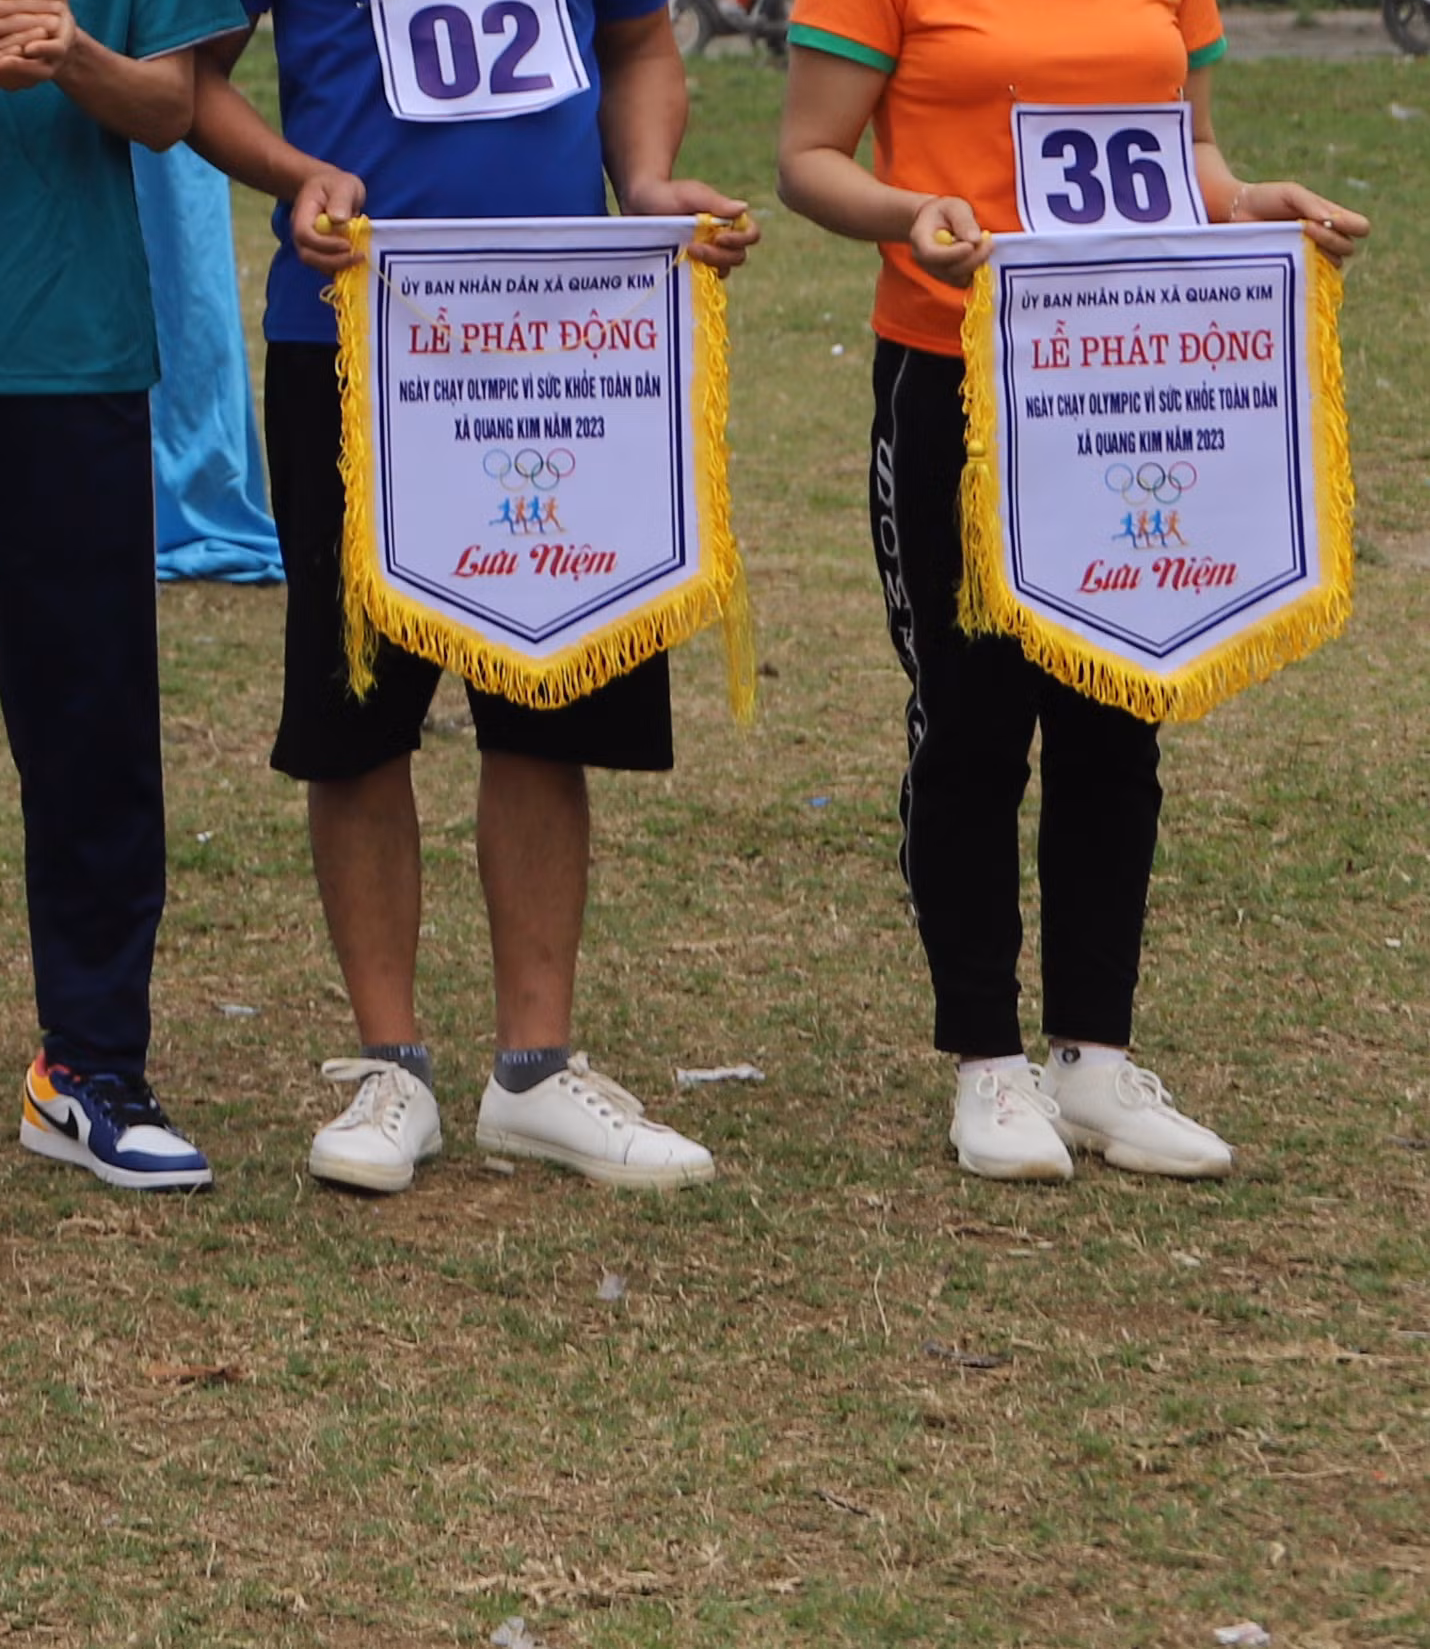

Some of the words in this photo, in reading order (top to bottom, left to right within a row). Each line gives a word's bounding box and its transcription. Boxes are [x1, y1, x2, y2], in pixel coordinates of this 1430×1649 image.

[408, 0, 554, 101] 02
[1041, 128, 1171, 224] 36
[409, 308, 453, 357] LỄ
[461, 312, 549, 354] PHÁT
[559, 309, 657, 359] ĐỘNG
[1031, 320, 1071, 370] LỄ
[1079, 323, 1170, 368] PHÁT
[1179, 322, 1275, 372] ĐỘNG
[473, 420, 514, 442] QUANG
[516, 418, 541, 439] KIM
[575, 416, 605, 439] 2023
